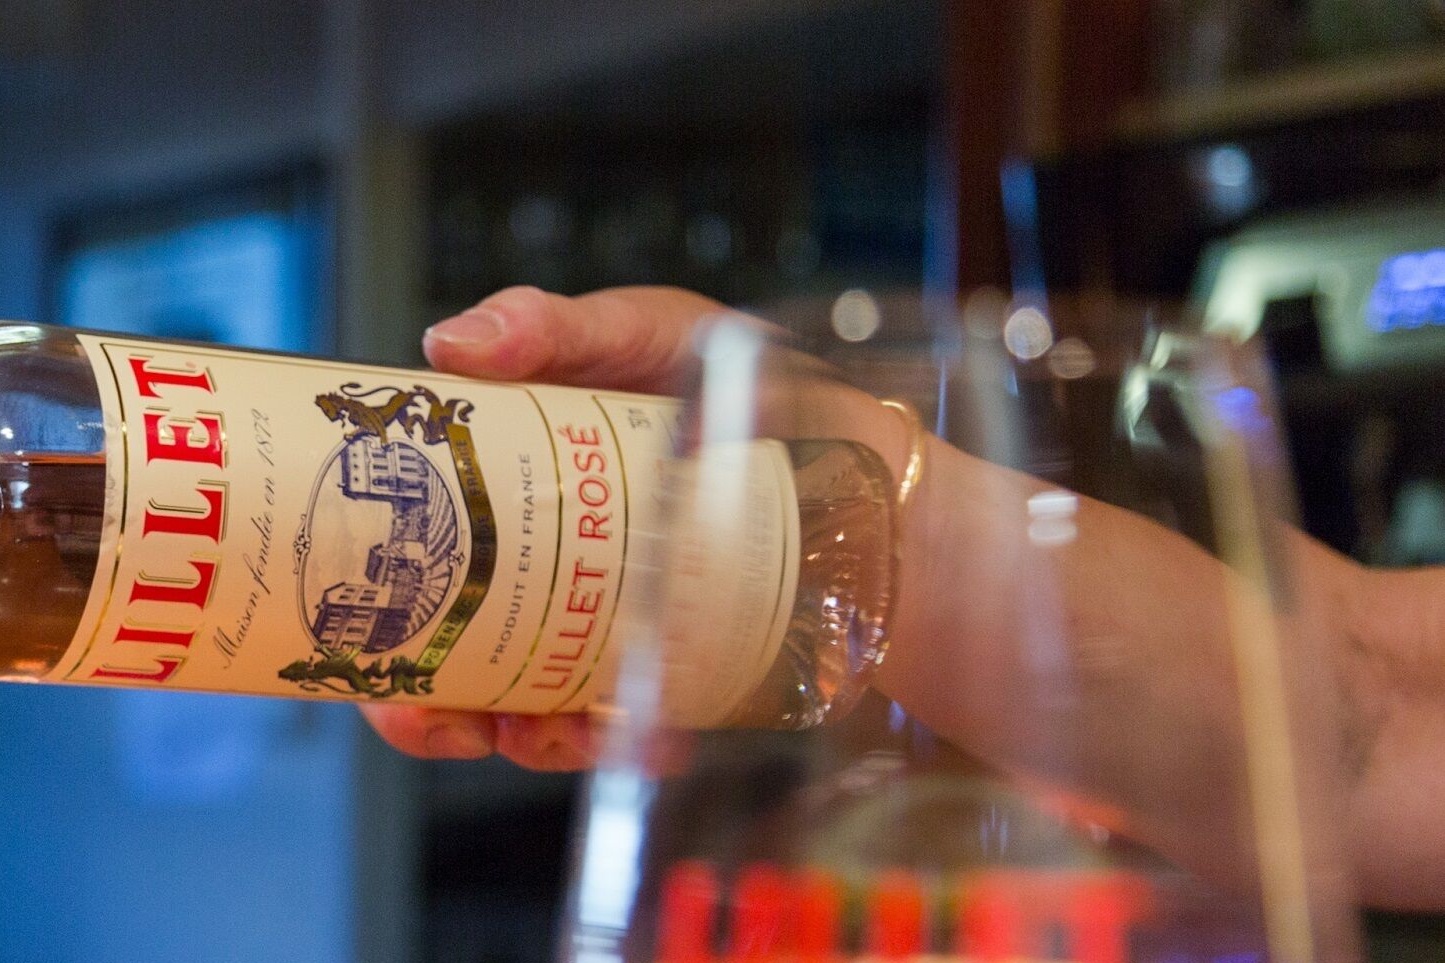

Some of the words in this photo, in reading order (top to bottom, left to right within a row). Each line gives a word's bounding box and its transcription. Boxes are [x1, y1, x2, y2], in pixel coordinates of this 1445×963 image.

[251, 408, 275, 467] 1872
[89, 354, 227, 683] LILLET
[264, 477, 275, 506] en
[519, 452, 535, 535] FRANCE
[557, 422, 611, 541] ROSÉ
[243, 511, 273, 595] fondée
[518, 545, 532, 573] EN
[213, 591, 258, 669] Maison
[490, 581, 526, 665] PRODUIT
[531, 558, 606, 690] LILLET
